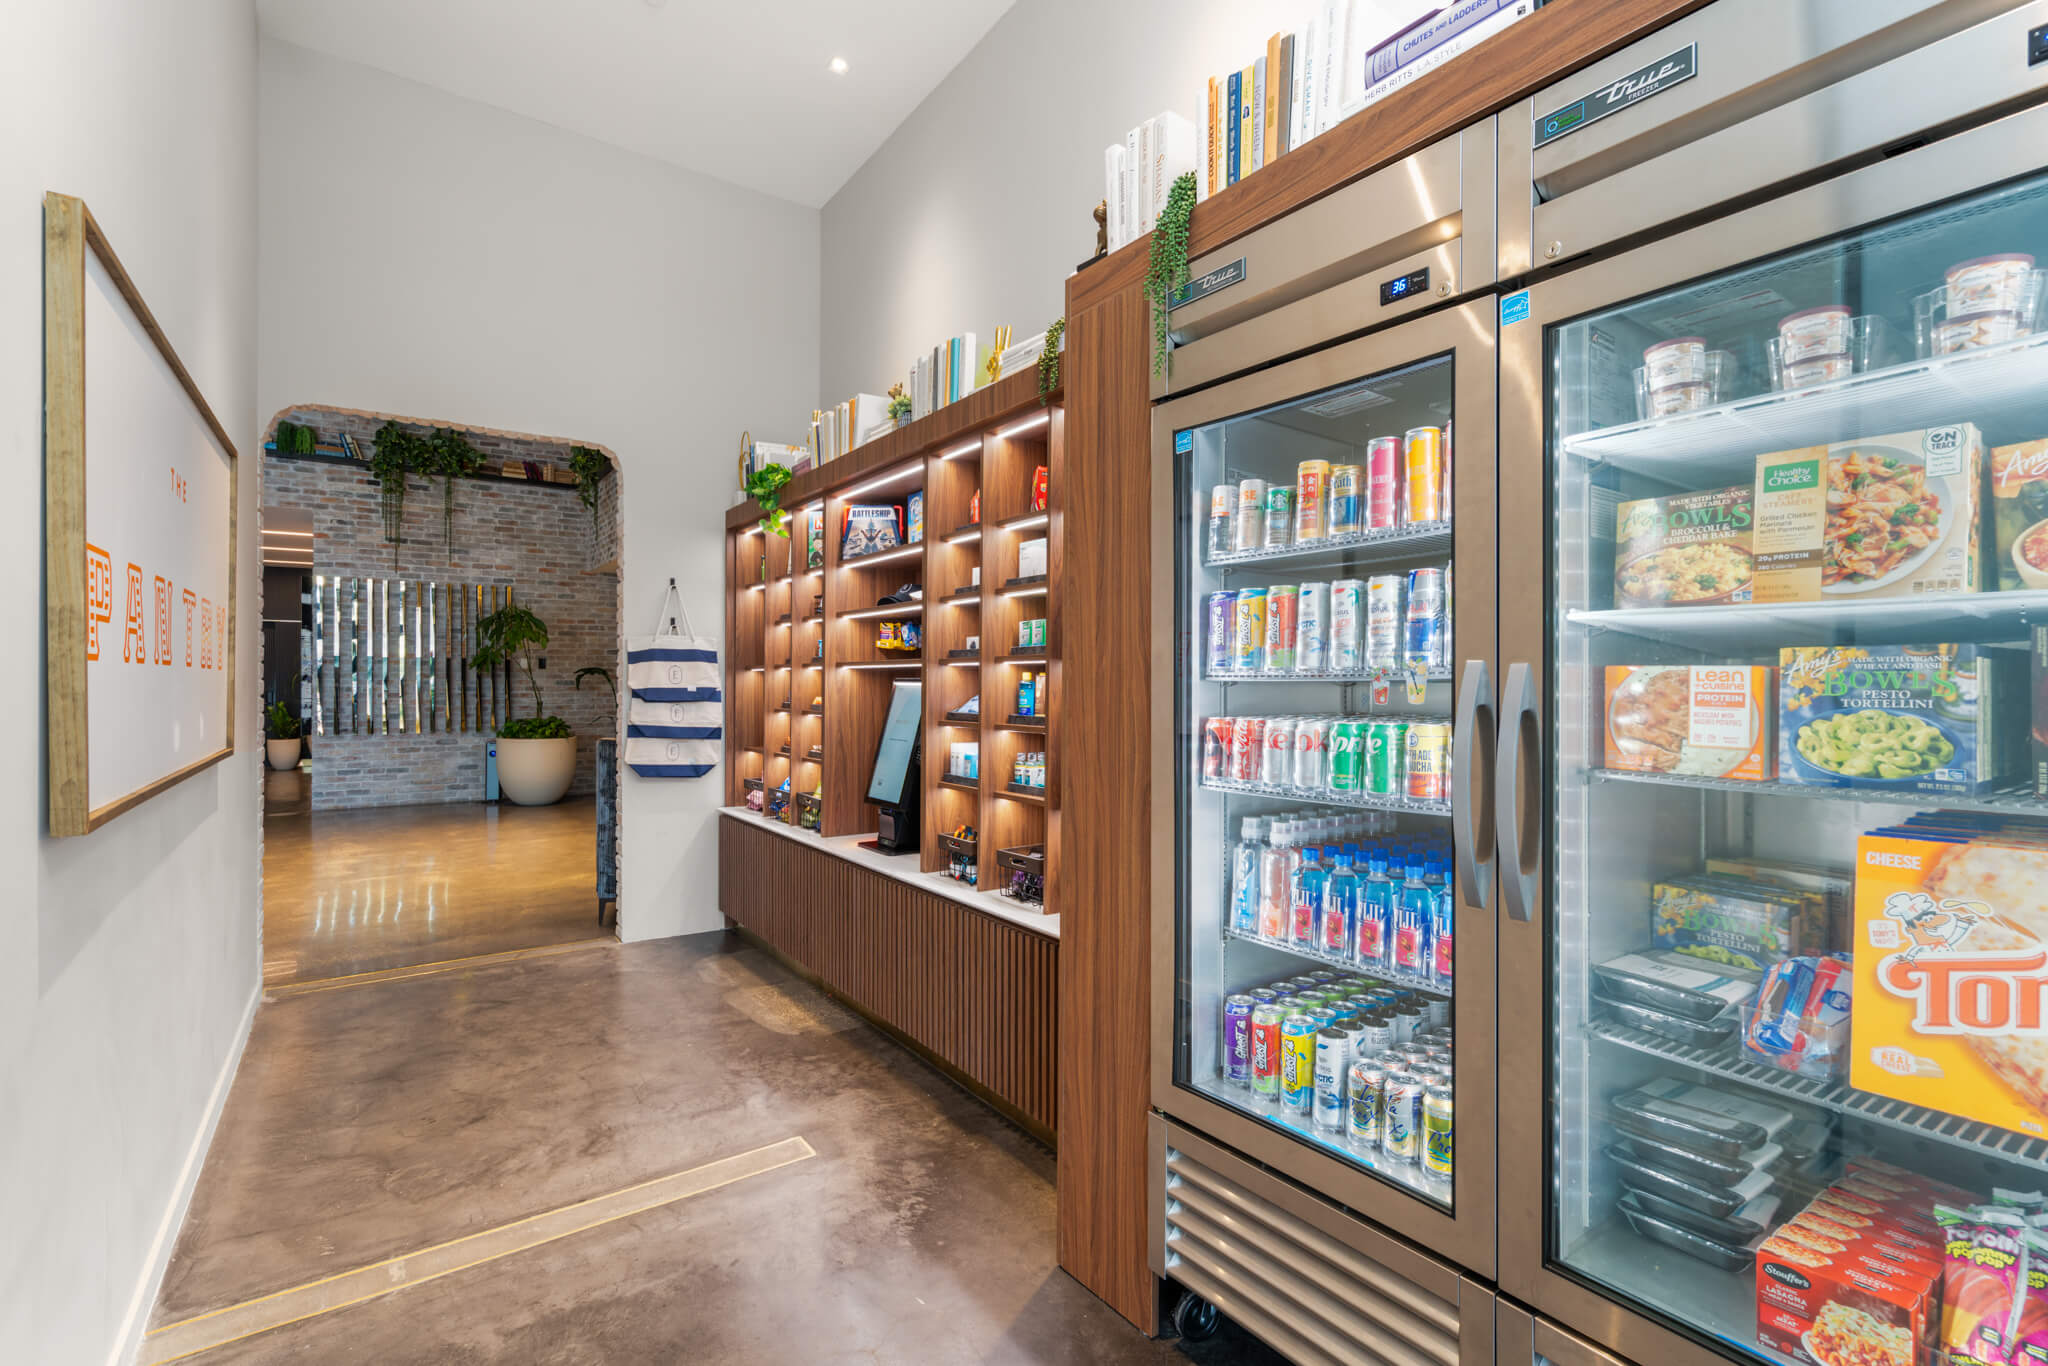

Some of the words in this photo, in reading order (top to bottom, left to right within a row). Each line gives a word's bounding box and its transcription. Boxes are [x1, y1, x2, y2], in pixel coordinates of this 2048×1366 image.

[1403, 27, 1434, 52] CHUTES
[1435, 21, 1447, 33] AND
[1448, 0, 1489, 25] LADDERS
[1364, 83, 1388, 102] HERB
[1389, 70, 1413, 89] RITTS
[1628, 82, 1661, 102] FREEZER
[1392, 278, 1407, 295] 36
[1931, 441, 1956, 450] TRACK
[1768, 473, 1812, 487] Choice
[1773, 467, 1811, 479] Healthy
[170, 466, 187, 504] THE
[852, 509, 892, 519] BATTLESHIP
[1651, 503, 1752, 537] BOWLS
[1663, 533, 1709, 545] CHEDDAR
[1711, 529, 1738, 540] BAKE
[1671, 523, 1721, 537] BROCCOLI
[1773, 552, 1810, 561] PROTEIN
[86, 541, 227, 672] PANTRY
[1784, 649, 1844, 685] Amy's
[1905, 655, 1953, 663] ORGANIC
[1695, 670, 1745, 682] Lean
[1821, 670, 1958, 697] BOWLS
[1696, 694, 1744, 703] PROTEIN
[1862, 689, 1911, 699] PESTO
[1840, 698, 1934, 709] TORTELLINI
[1865, 851, 1922, 870] CHEESE
[1683, 909, 1777, 947] BOWLS
[1710, 928, 1745, 942] PESTO
[1696, 933, 1761, 953] TORTELLINI
[1764, 1264, 1810, 1288] Stouffer's
[1765, 1284, 1808, 1306] LASAGNA
